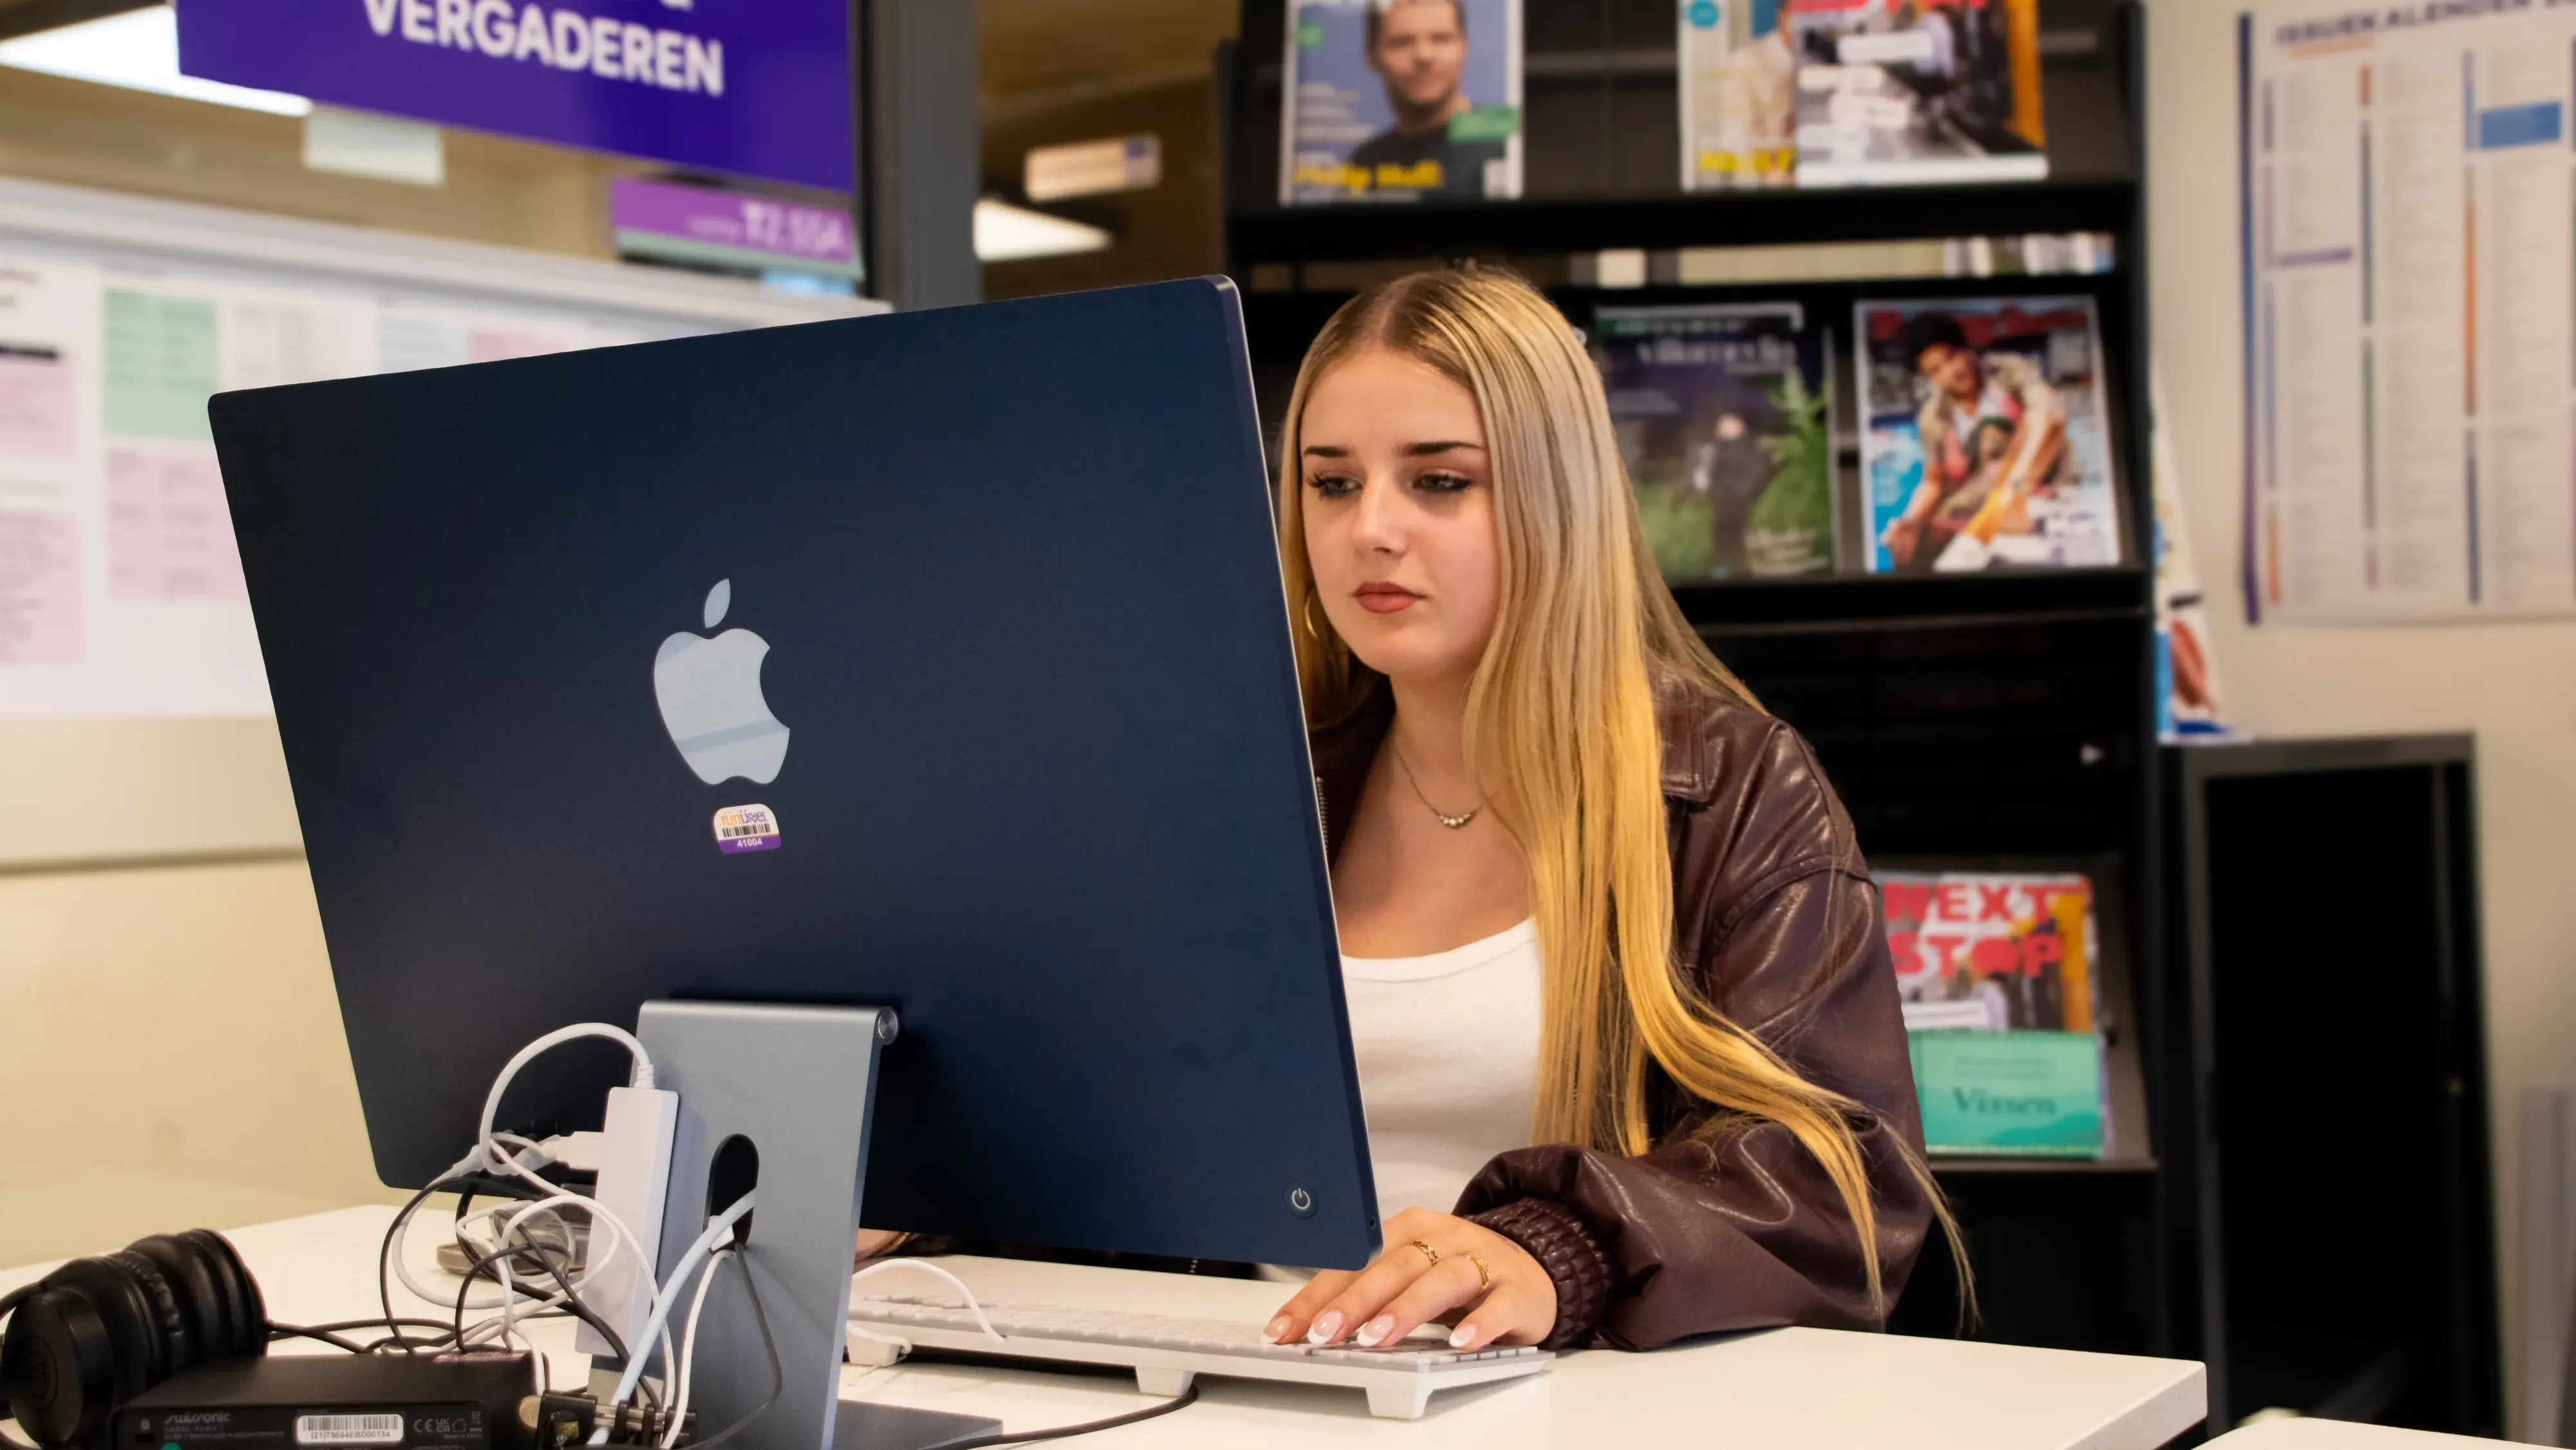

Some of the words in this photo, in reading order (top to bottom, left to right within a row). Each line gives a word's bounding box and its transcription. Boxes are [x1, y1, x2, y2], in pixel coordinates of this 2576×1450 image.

[363, 0, 724, 97] VERGADEREN
[737, 837, 763, 848] 41004
[1882, 881, 2088, 924] NEXT
[1887, 932, 2065, 977] STOP
